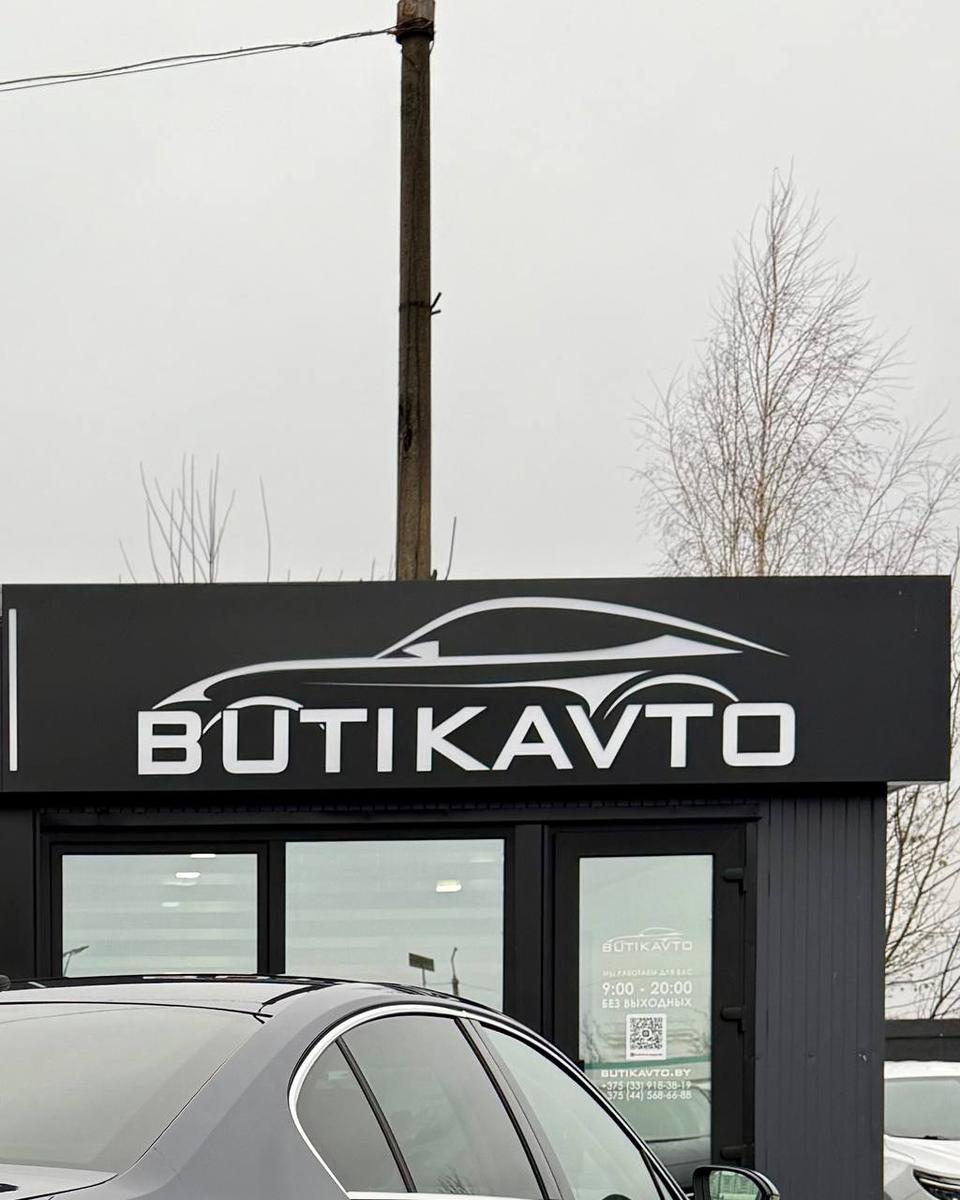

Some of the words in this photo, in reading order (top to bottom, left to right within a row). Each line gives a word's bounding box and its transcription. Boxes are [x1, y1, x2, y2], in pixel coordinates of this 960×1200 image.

[138, 702, 796, 776] BUTIKAVTO
[602, 940, 693, 952] BUTIKAVTO
[602, 982, 634, 996] 9:00
[650, 981, 693, 995] 20:00
[602, 998, 621, 1009] БЕЗ
[624, 998, 693, 1009] ВЫХОДНЫХ
[601, 1068, 692, 1078] BUTIKAVTO.BY
[606, 1091, 624, 1100] 375
